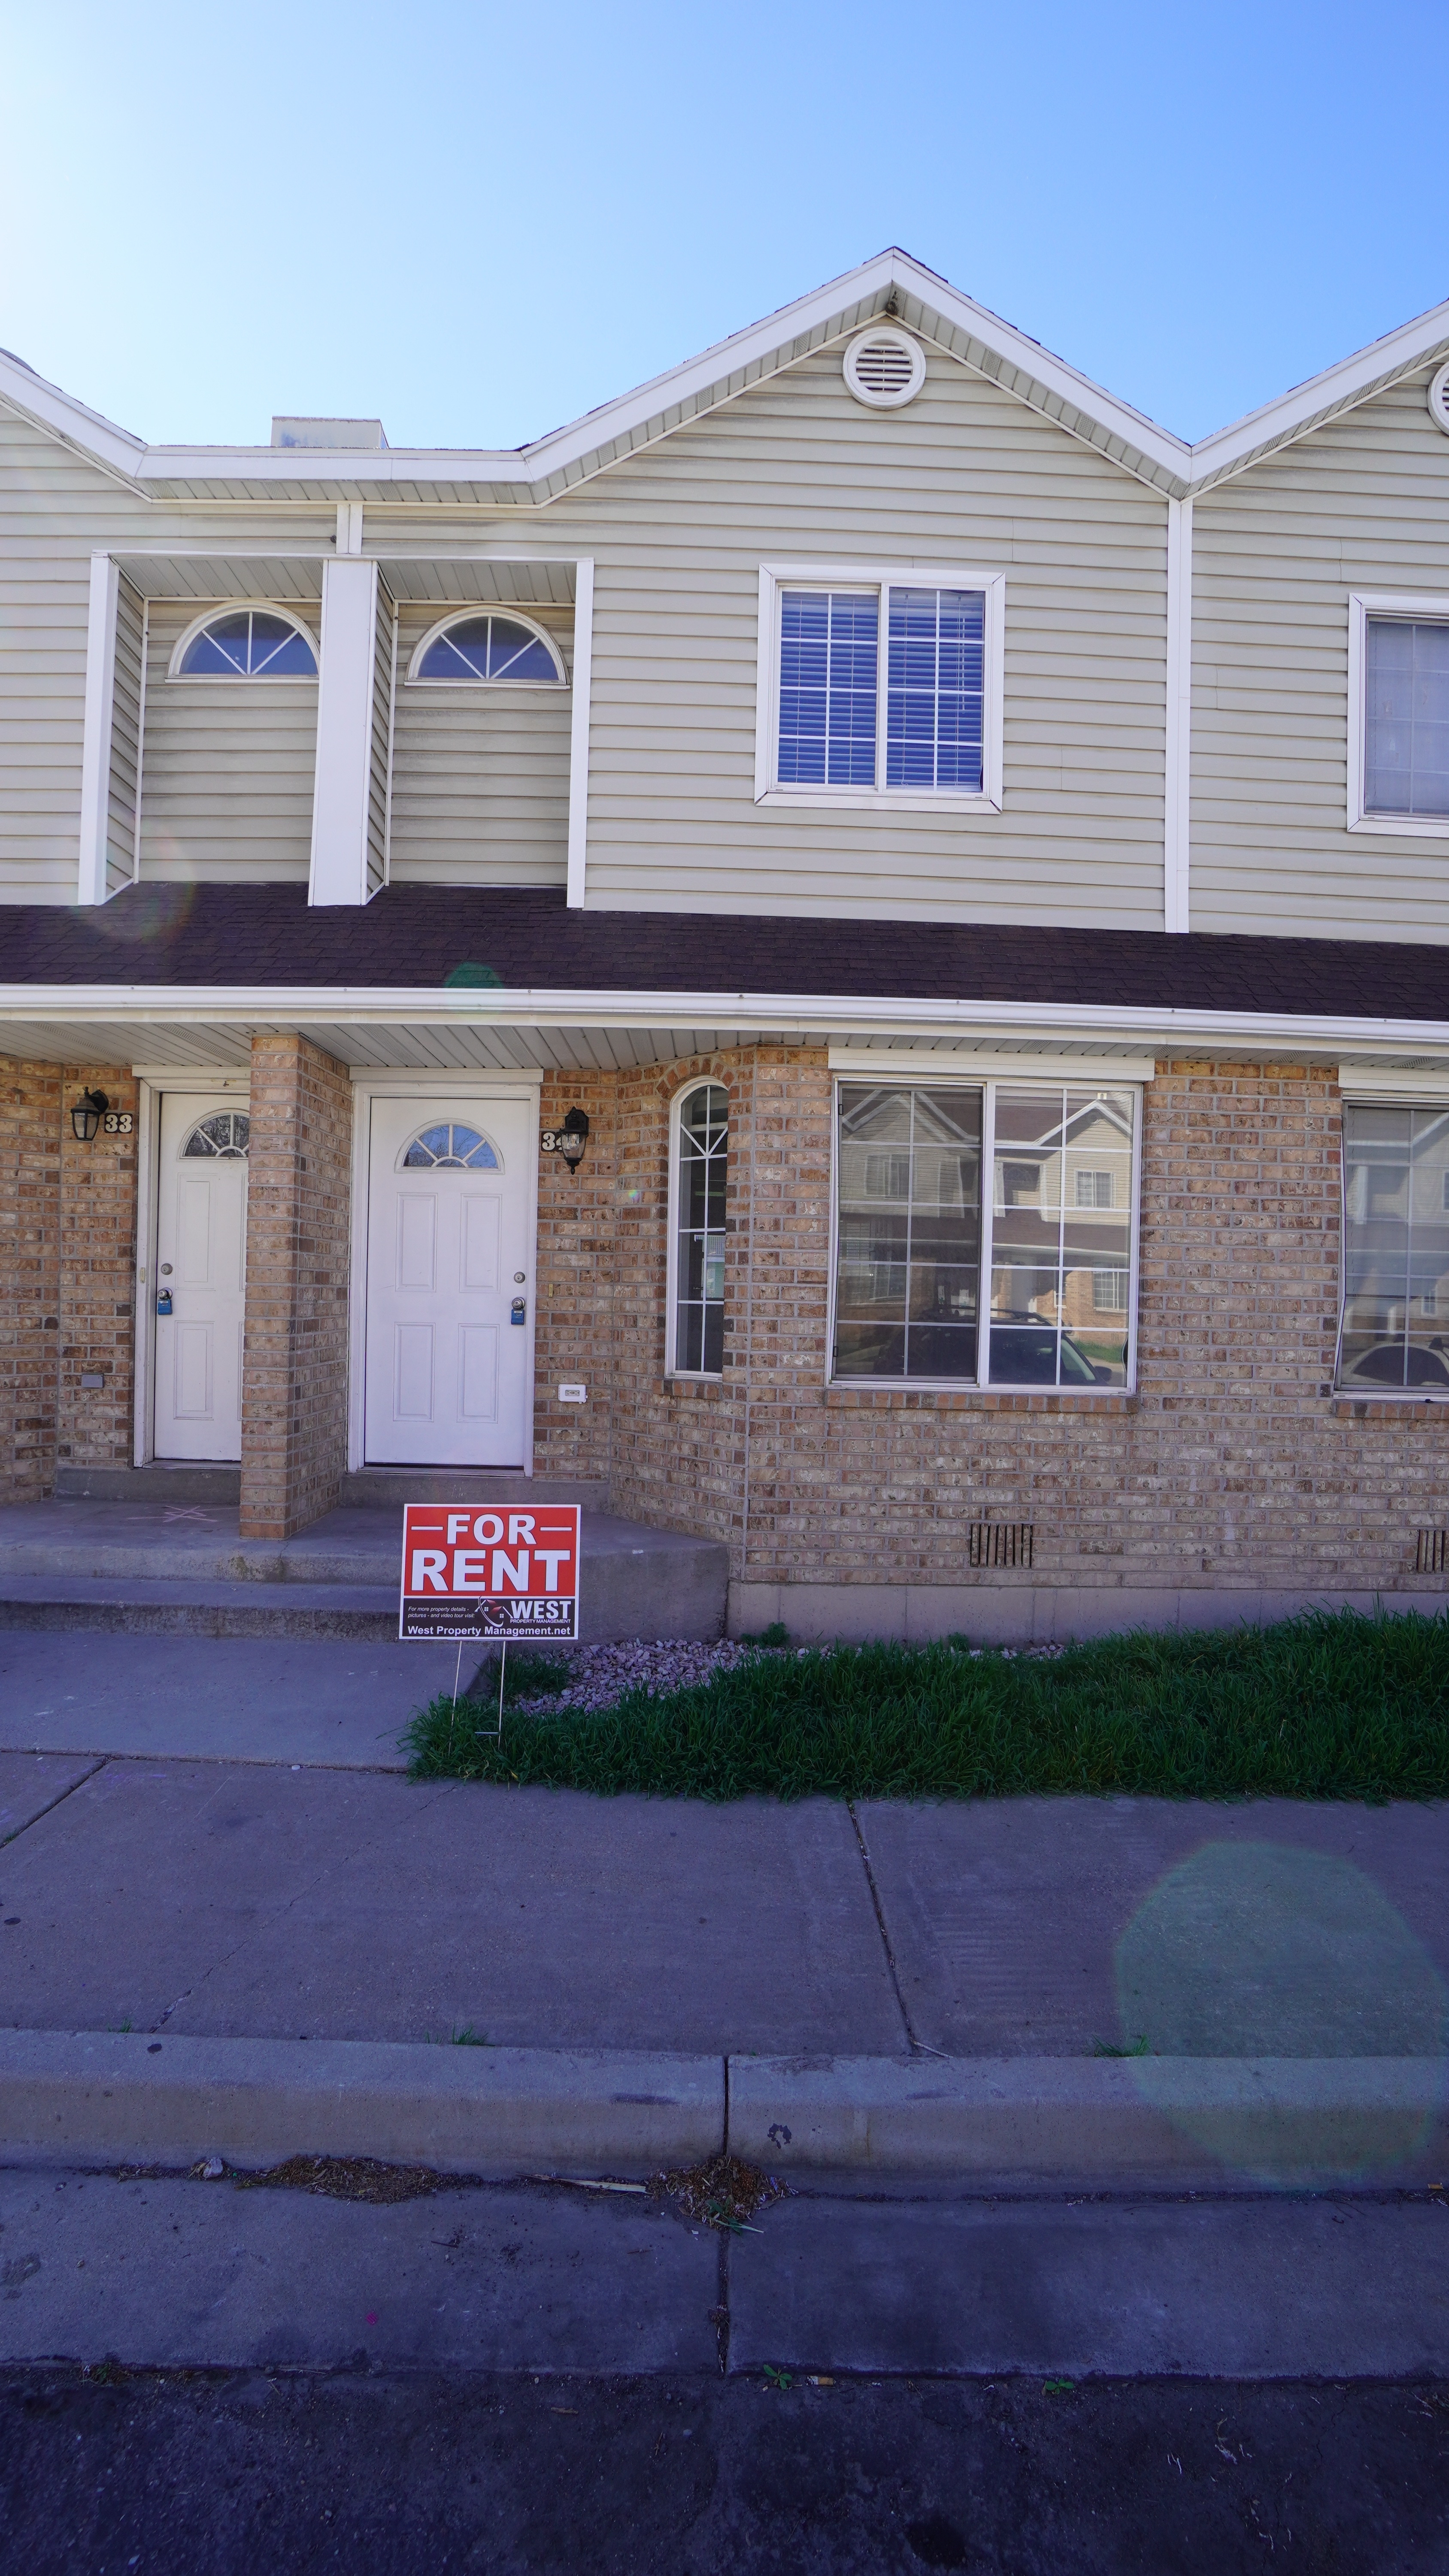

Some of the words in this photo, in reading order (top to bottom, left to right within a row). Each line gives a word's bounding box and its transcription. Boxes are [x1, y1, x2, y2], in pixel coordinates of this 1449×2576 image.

[105, 1114, 132, 1133] 33
[447, 1514, 537, 1545] FOR
[411, 1549, 570, 1592] RENT
[510, 1601, 571, 1619] WEST
[408, 1626, 433, 1634] West
[437, 1626, 481, 1636] Property
[485, 1626, 570, 1637] Management.net
